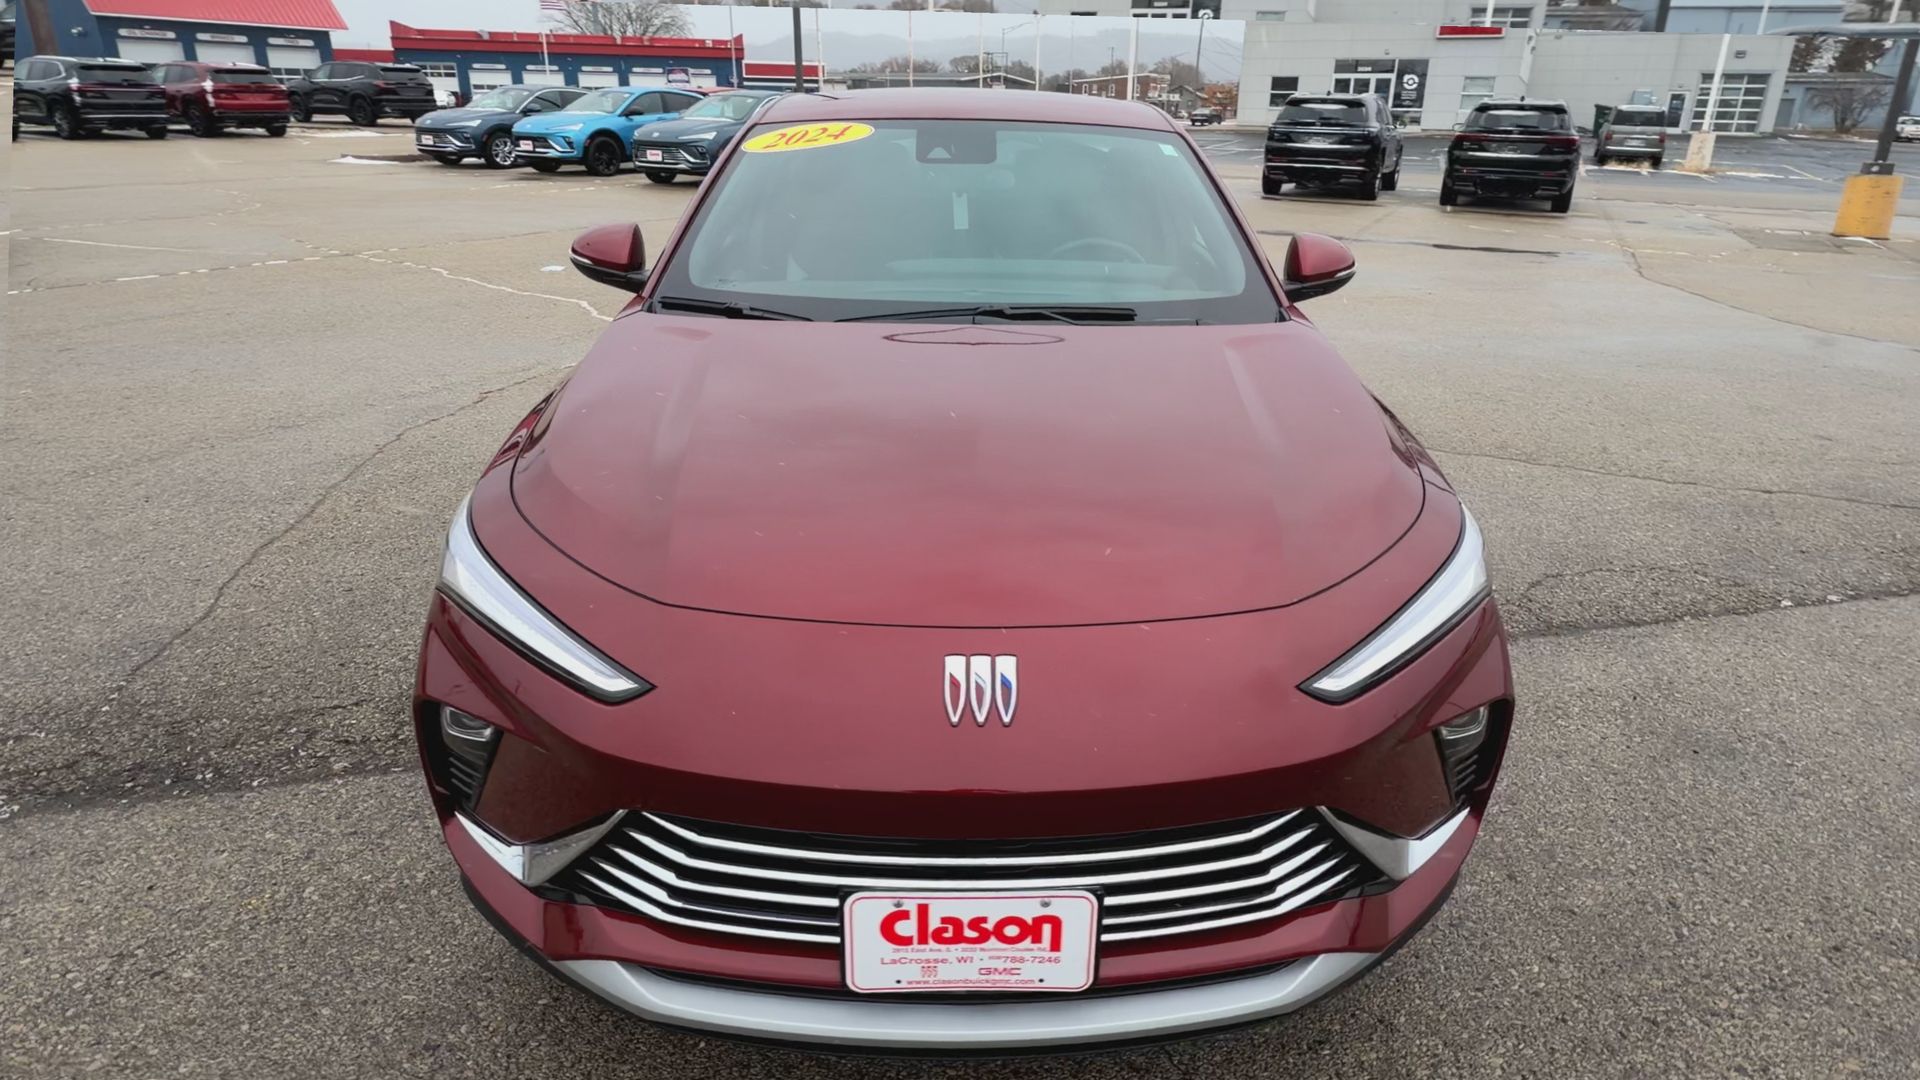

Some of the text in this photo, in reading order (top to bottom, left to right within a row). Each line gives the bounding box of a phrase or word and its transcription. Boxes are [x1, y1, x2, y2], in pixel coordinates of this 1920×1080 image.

[762, 125, 853, 150] 2024
[879, 903, 1062, 952] Clason
[956, 955, 974, 964] WI
[978, 967, 1022, 976] GMC
